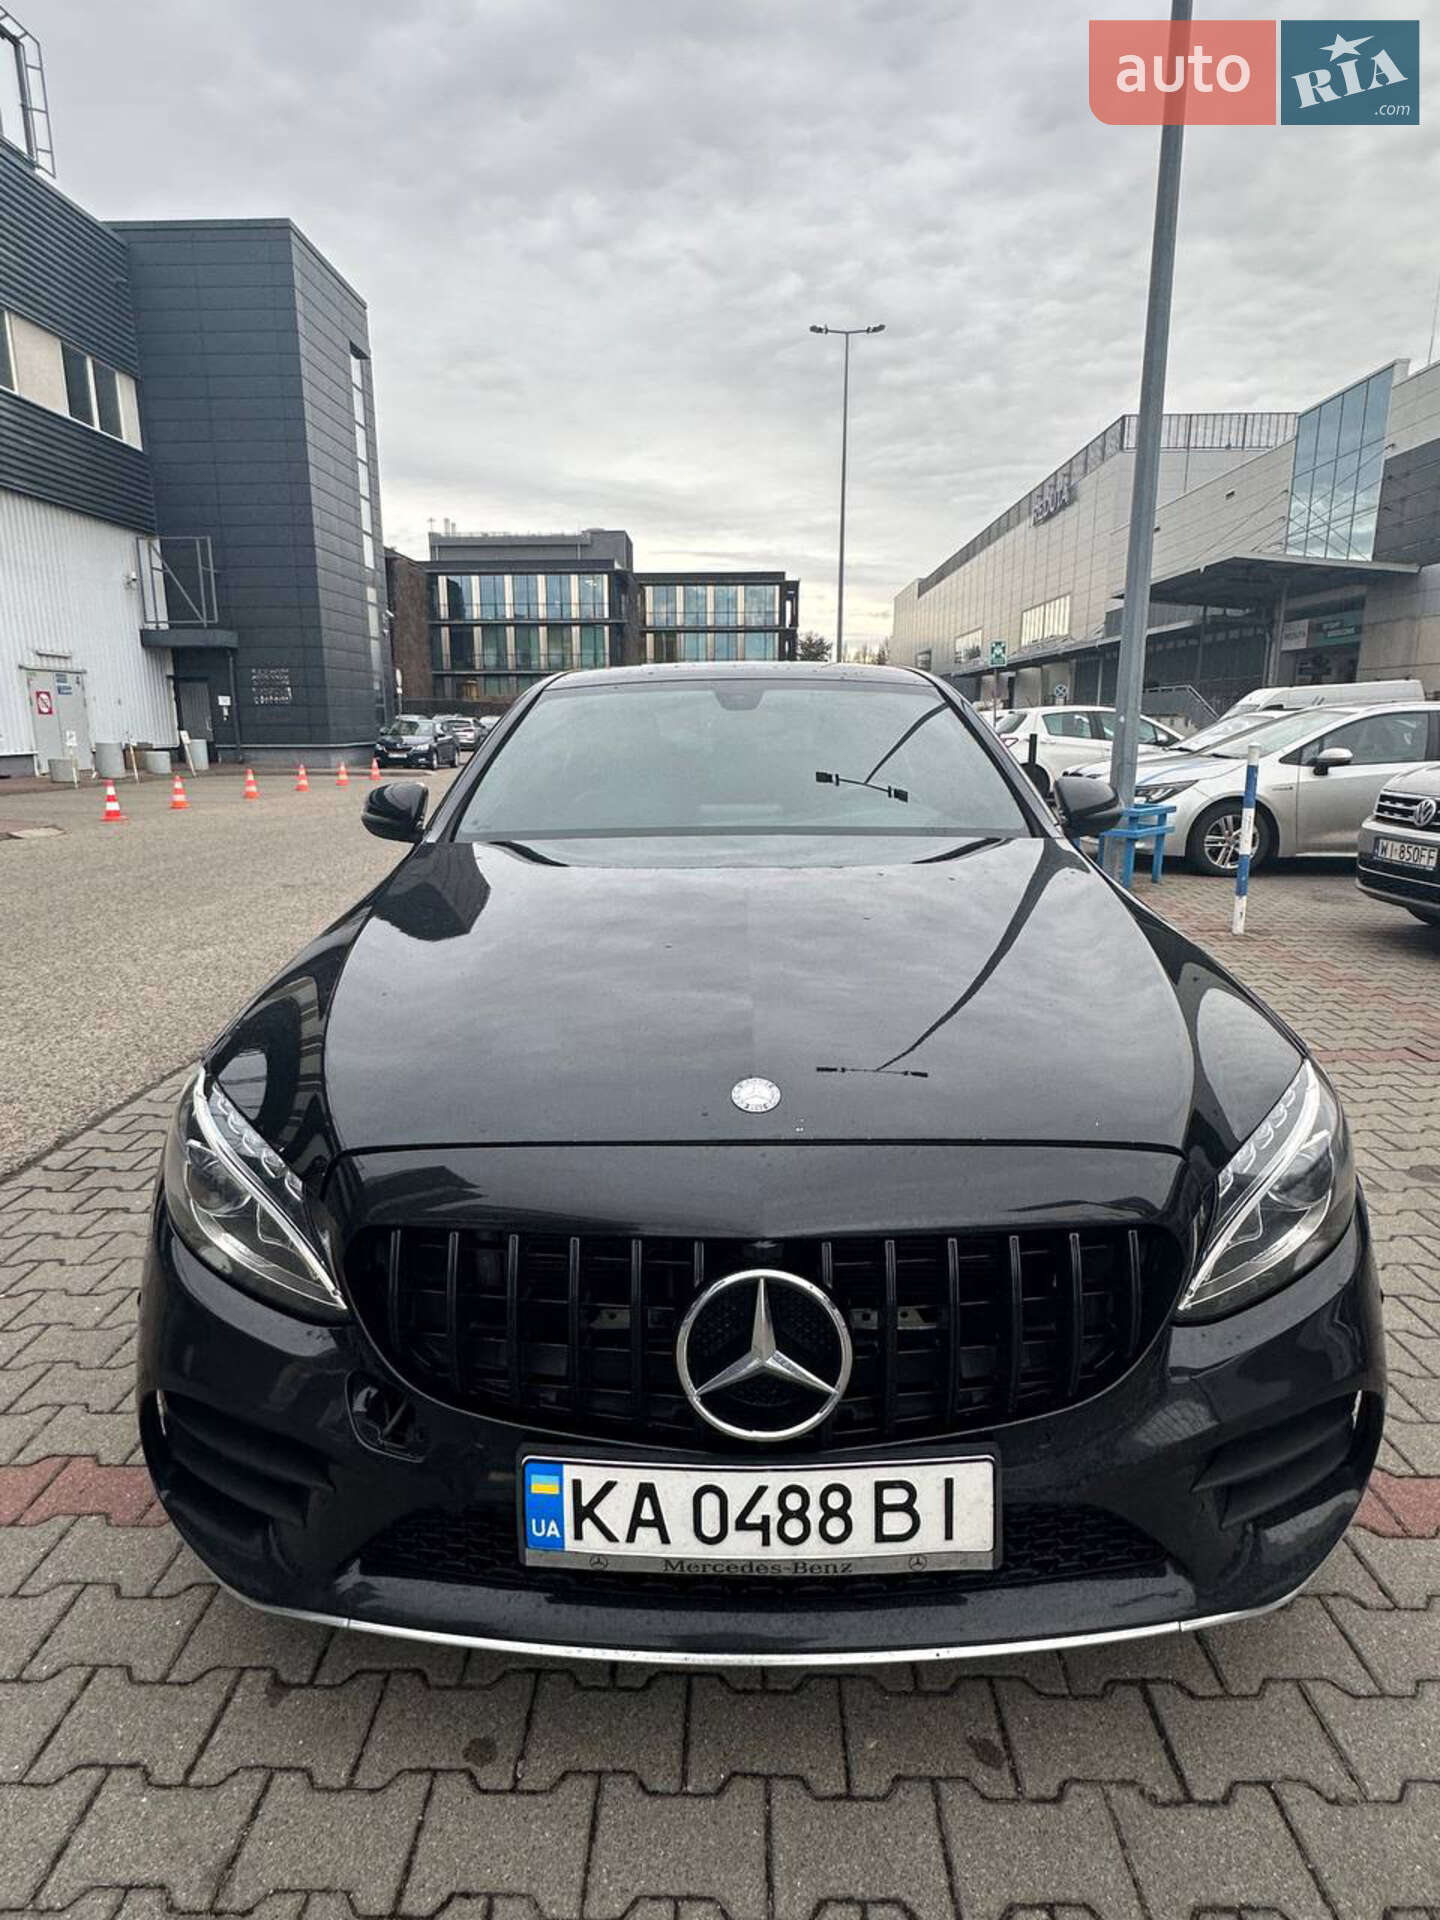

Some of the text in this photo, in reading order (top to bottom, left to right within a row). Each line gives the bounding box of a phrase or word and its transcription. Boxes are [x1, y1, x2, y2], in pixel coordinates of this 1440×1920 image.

[571, 1477, 954, 1547] KA 0488 BI
[531, 1518, 561, 1538] UA
[662, 1558, 853, 1575] Mercedes-Benz
